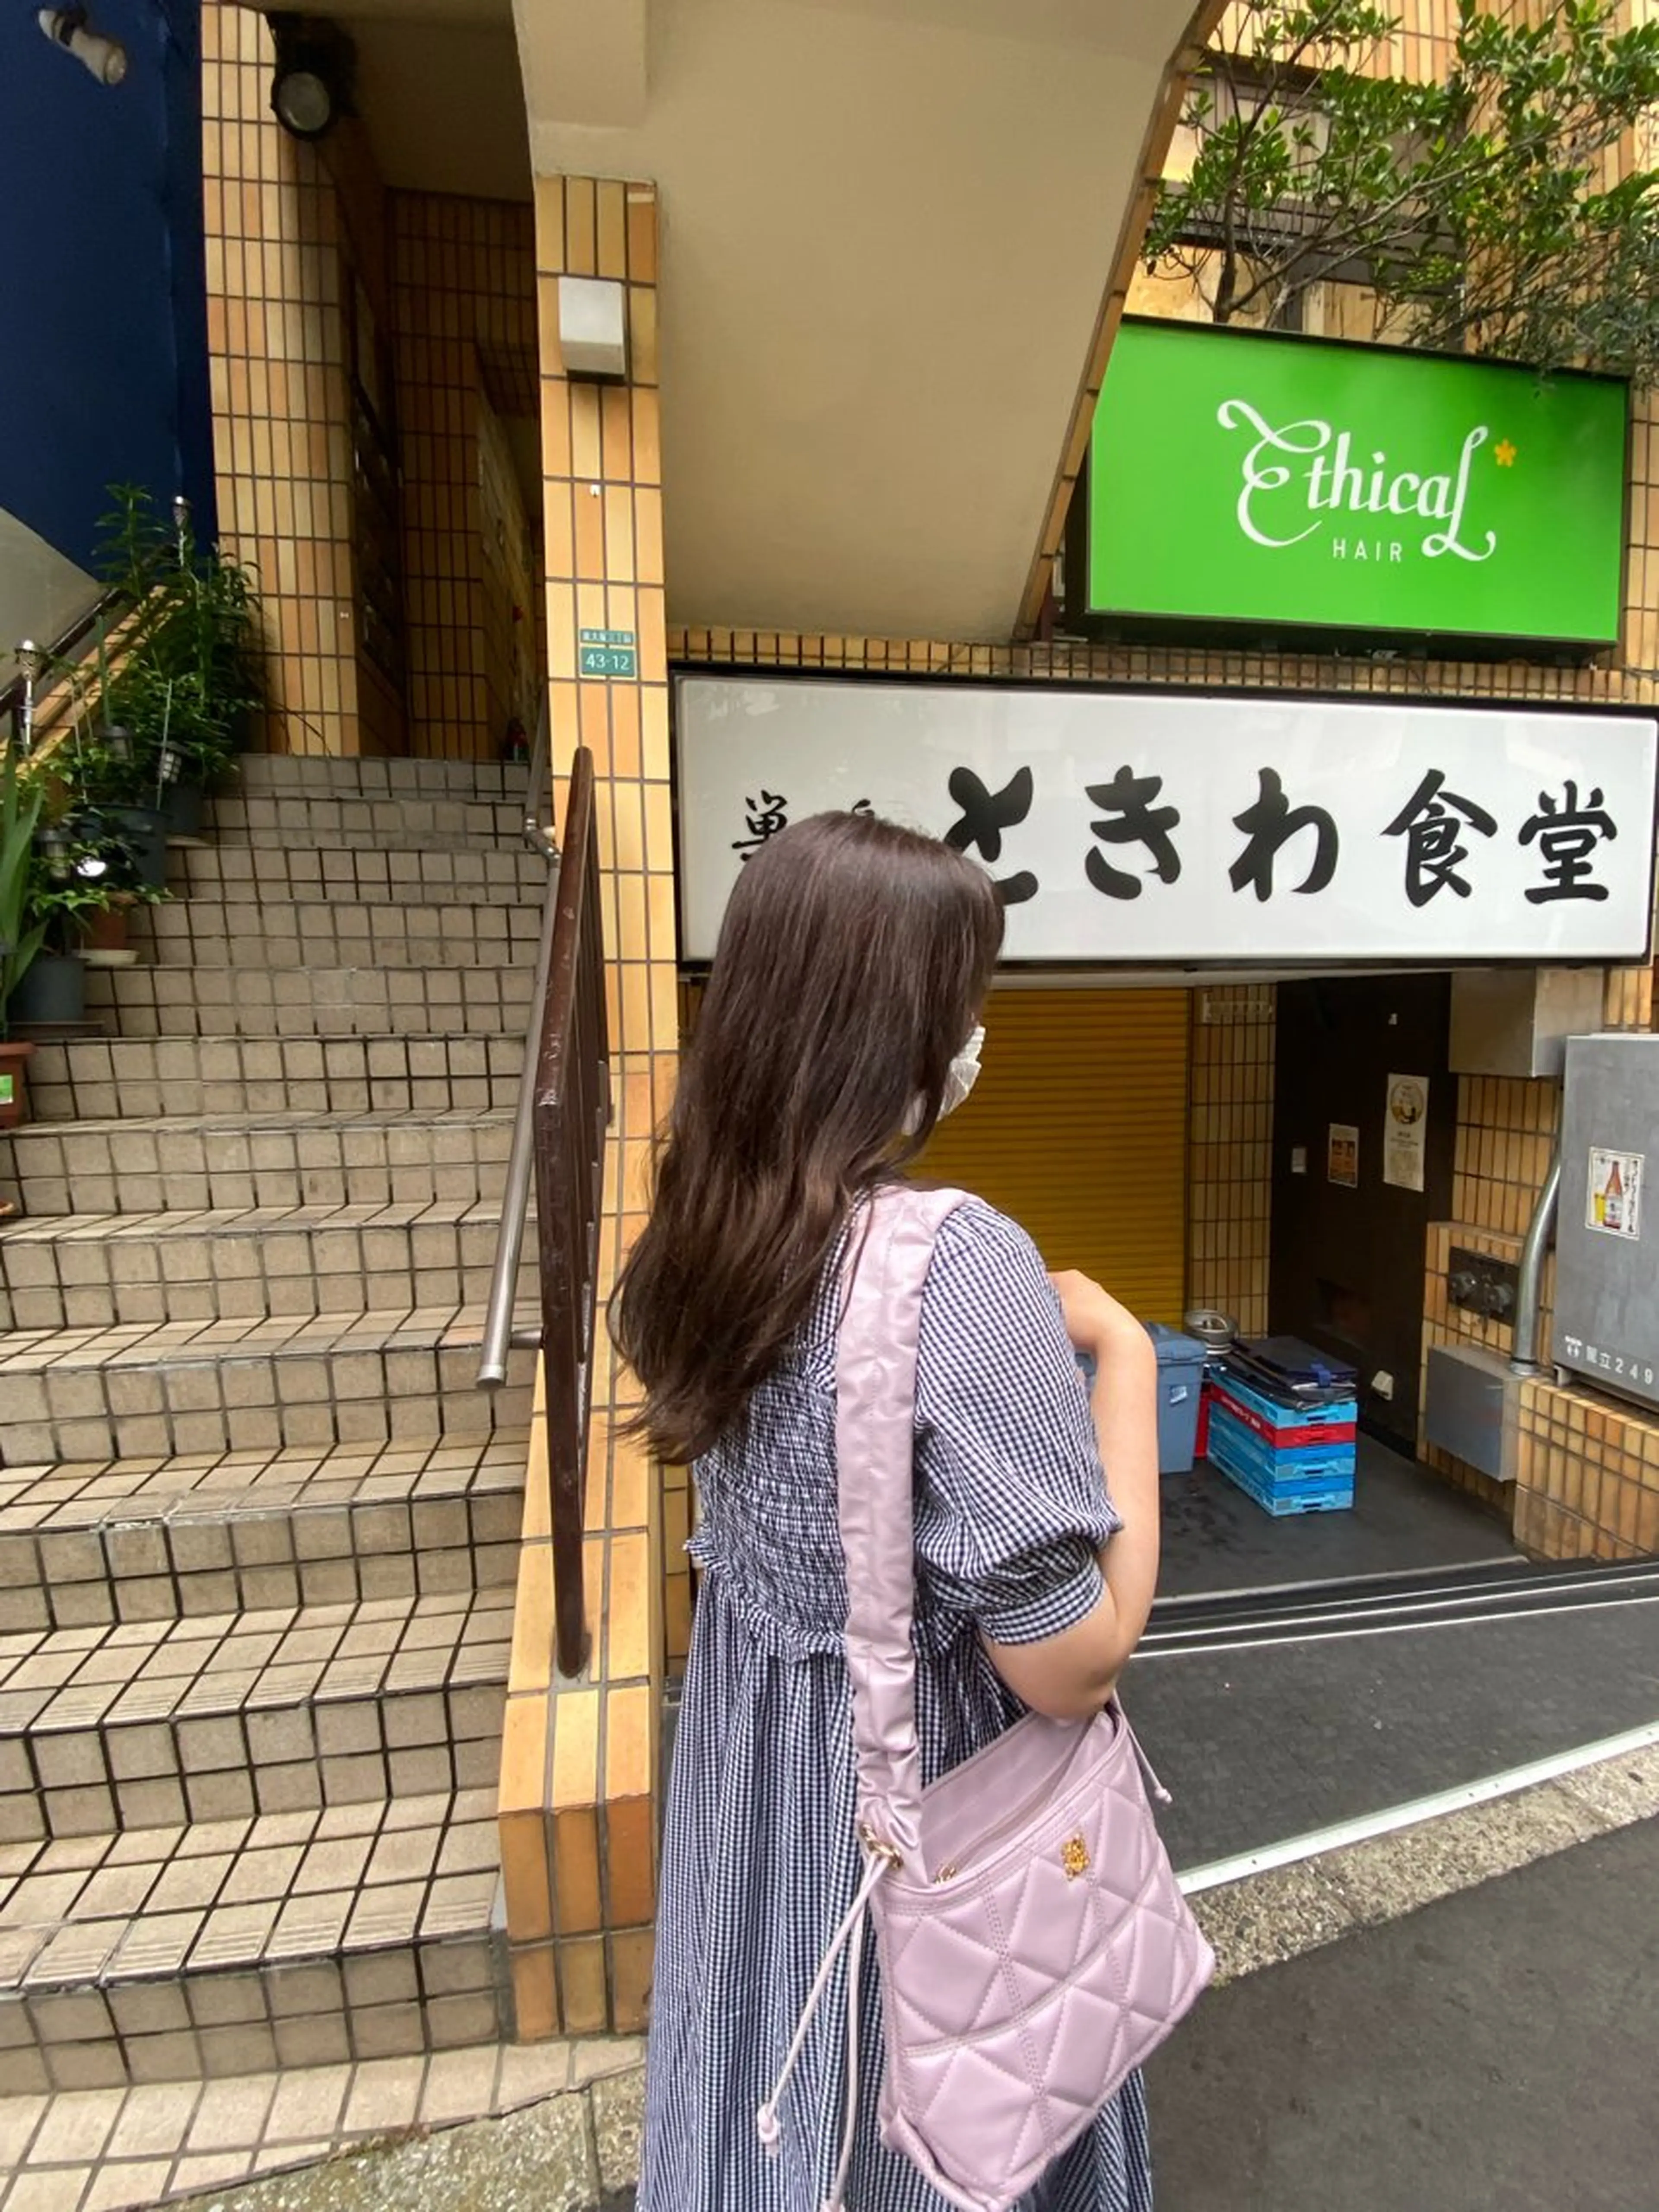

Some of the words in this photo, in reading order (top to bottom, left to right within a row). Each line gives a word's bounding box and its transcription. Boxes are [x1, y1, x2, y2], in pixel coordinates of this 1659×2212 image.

[1217, 399, 1496, 561] Ethical
[1333, 539, 1403, 562] HAIR
[585, 653, 630, 671] 43-12
